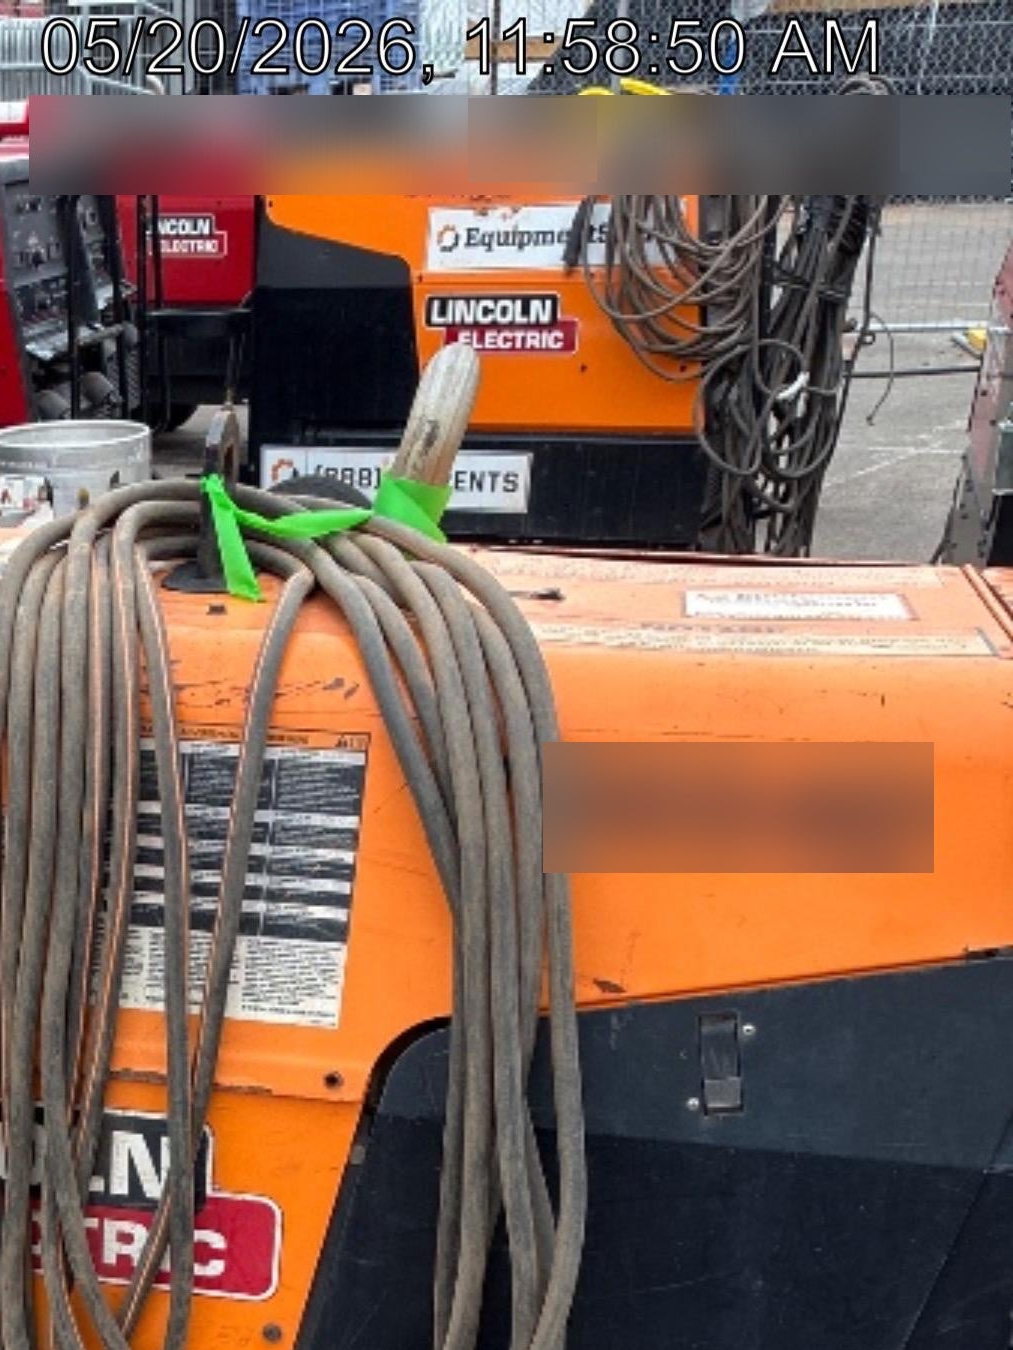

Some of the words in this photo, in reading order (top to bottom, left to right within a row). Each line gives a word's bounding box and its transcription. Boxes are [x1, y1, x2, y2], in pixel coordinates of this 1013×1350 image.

[431, 299, 552, 325] LINCOLN
[456, 330, 564, 349] ELECTRIC
[454, 470, 519, 493] ENTS
